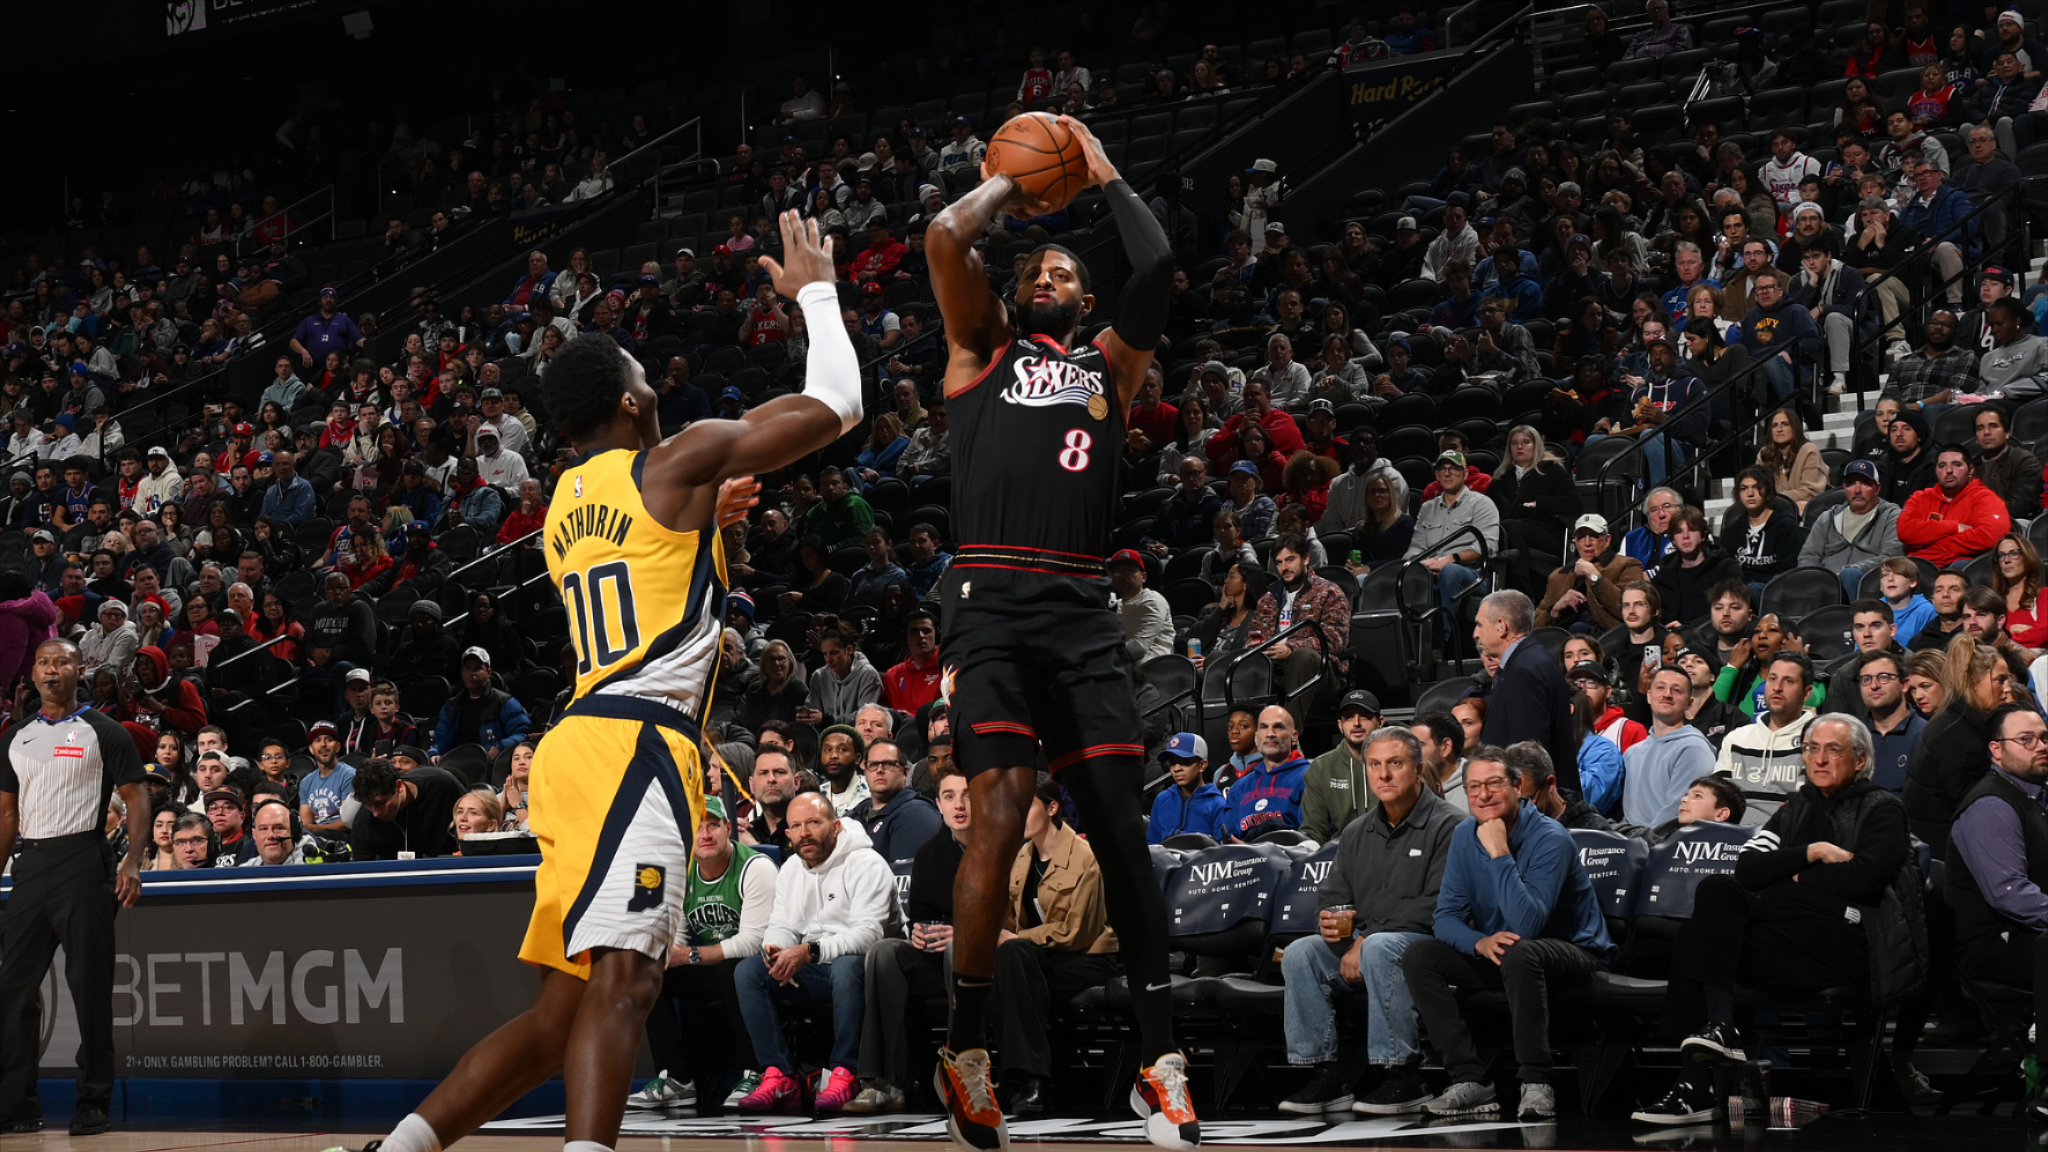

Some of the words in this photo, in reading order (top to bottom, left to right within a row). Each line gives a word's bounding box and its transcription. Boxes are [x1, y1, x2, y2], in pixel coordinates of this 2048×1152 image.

[1034, 85, 1044, 98] 6
[1351, 79, 1396, 105] Hard
[1003, 355, 1105, 403] SIXERS
[1058, 427, 1093, 473] 8
[553, 503, 633, 564] MATHURIN
[563, 560, 642, 677] 00
[55, 748, 83, 757] Emirates
[1241, 811, 1283, 831] SIXERS
[1587, 856, 1609, 867] Group
[1588, 847, 1625, 857] Insurance
[1672, 841, 1723, 865] NJM
[1188, 861, 1233, 886] NJM
[1233, 857, 1267, 869] Insurance
[1232, 866, 1253, 879] Group
[1669, 866, 1690, 874] AUTO.
[1716, 867, 1735, 875] REN
[688, 903, 742, 932] EAGLES
[113, 948, 405, 1026] BETMGM
[144, 1055, 169, 1069] ONLY.
[171, 1055, 220, 1069] GAMBLING
[222, 1055, 273, 1069] PROBLEM?
[274, 1055, 300, 1069] CALL
[300, 1055, 384, 1069] 1-800-GAMBLER.
